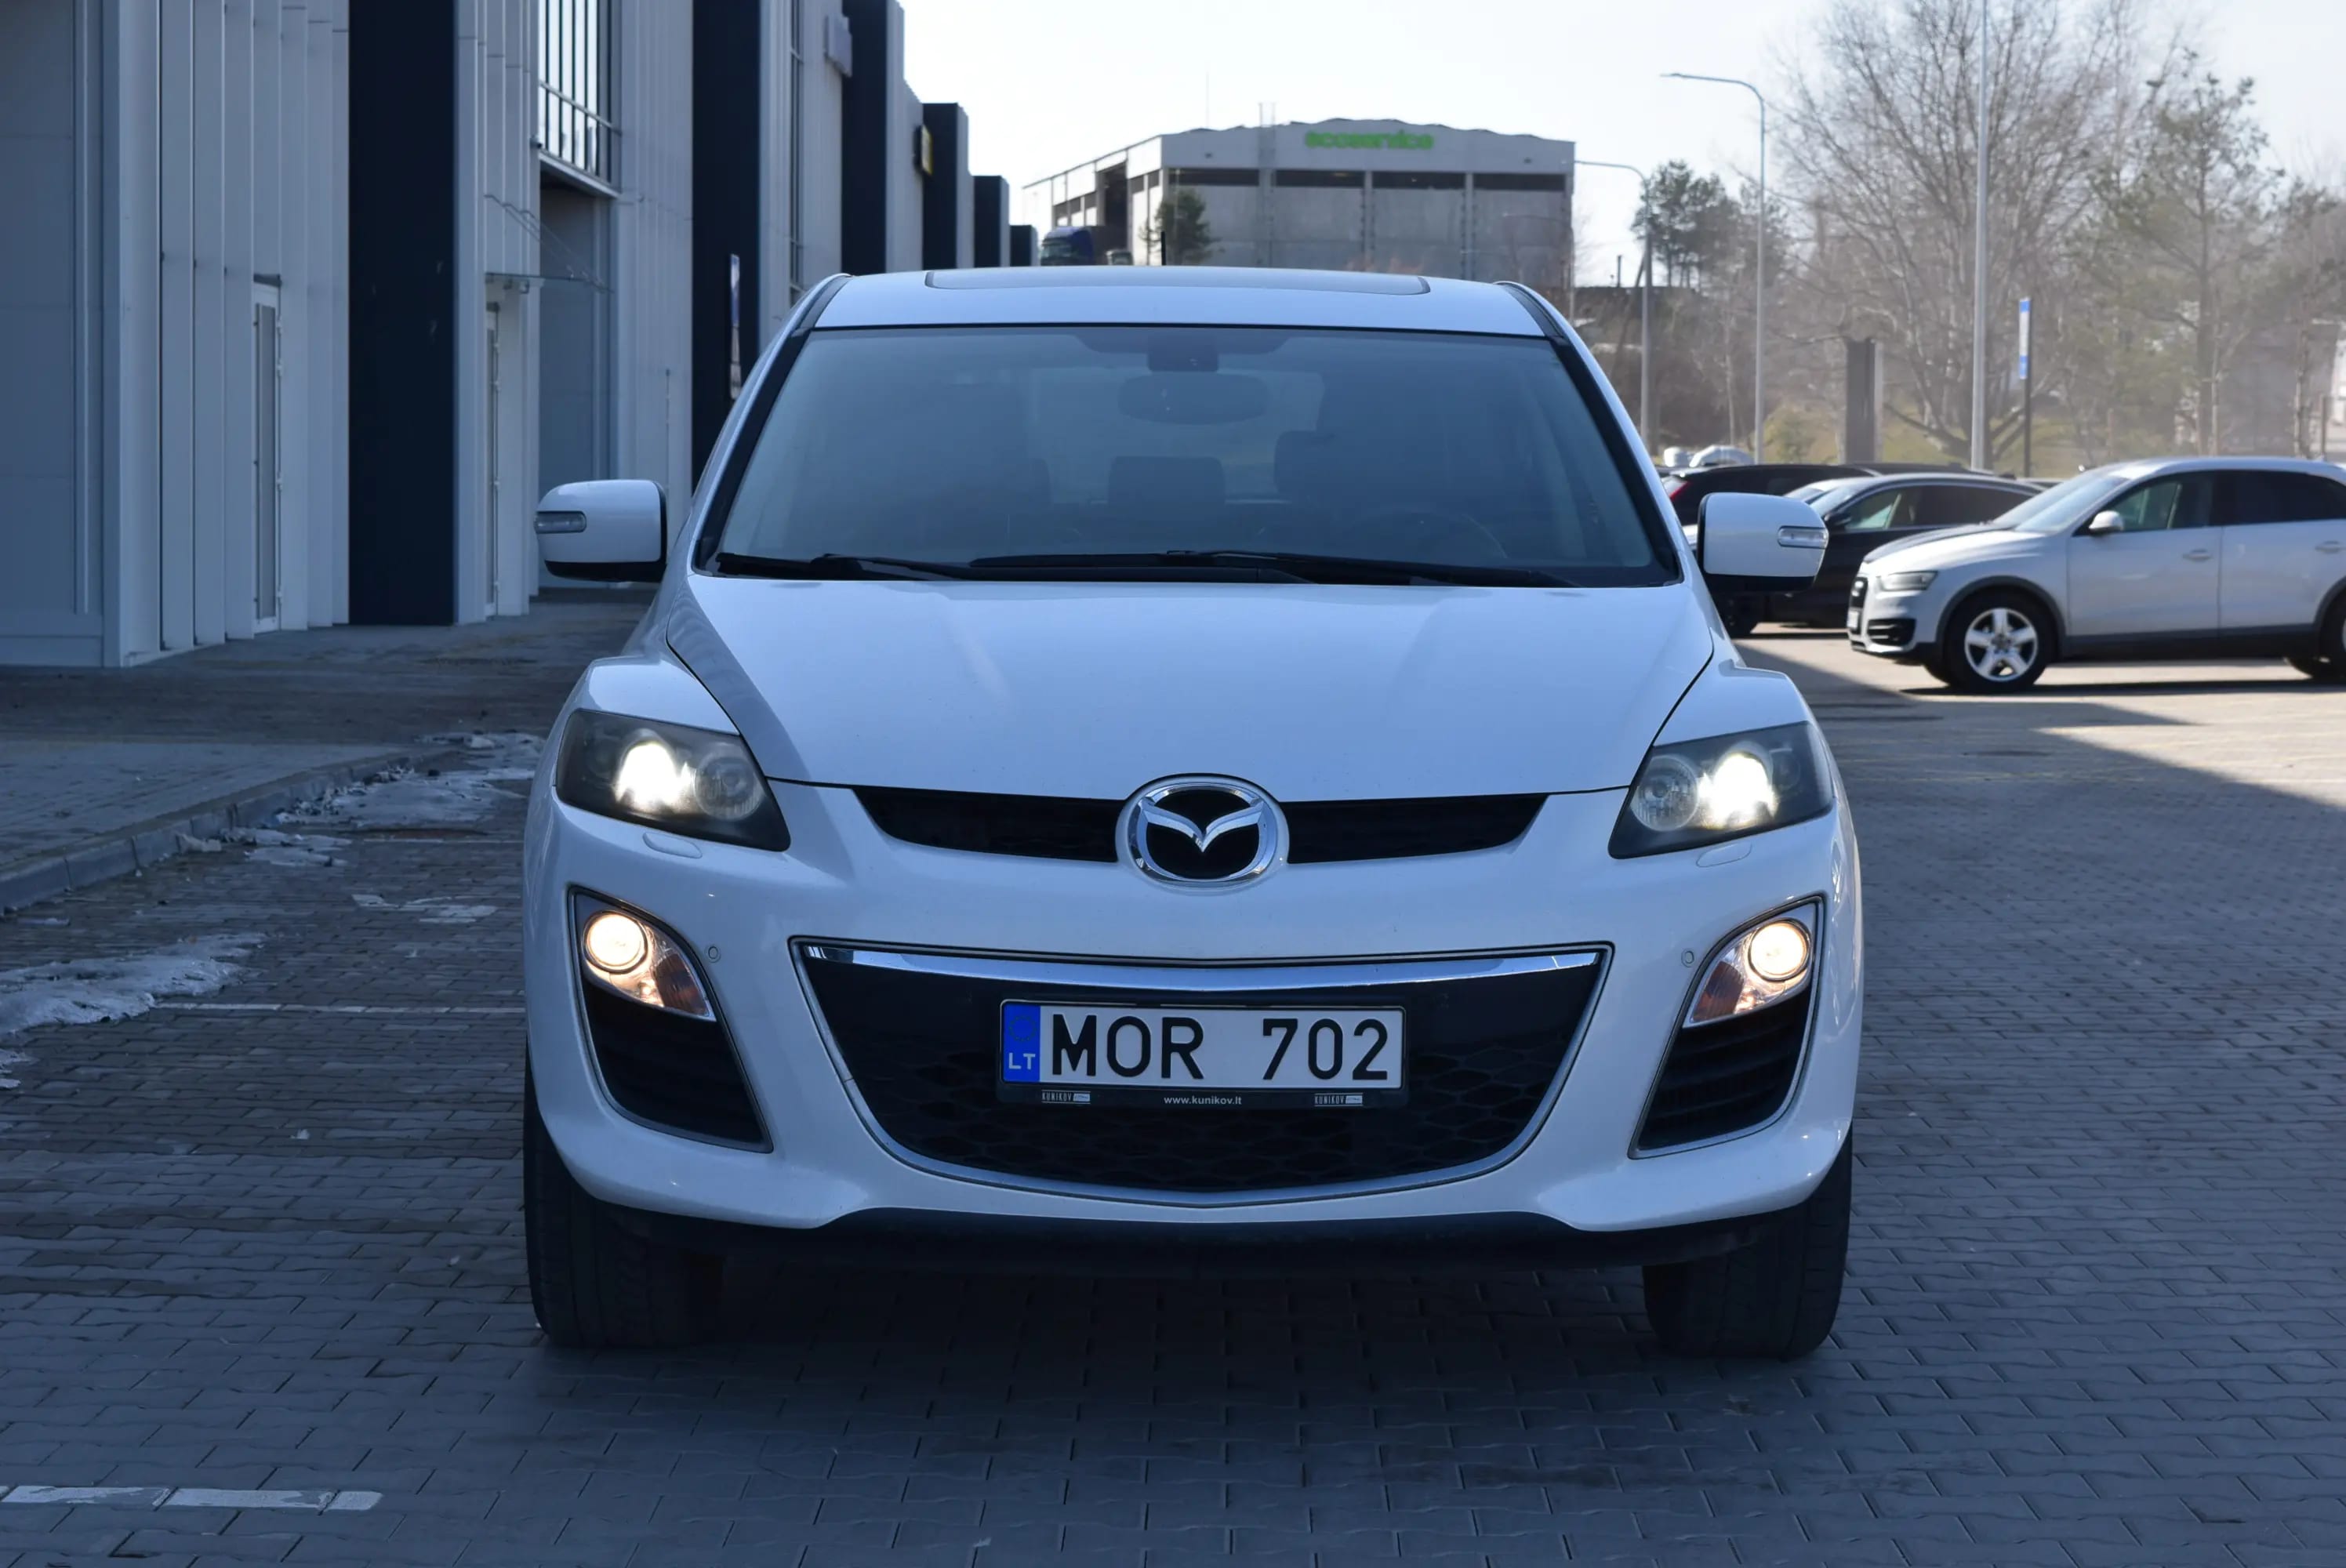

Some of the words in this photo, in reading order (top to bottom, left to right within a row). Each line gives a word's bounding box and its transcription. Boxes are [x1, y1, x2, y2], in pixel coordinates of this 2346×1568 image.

[1052, 1014, 1204, 1080] MOR
[1262, 1018, 1388, 1081] 702
[1008, 1051, 1036, 1069] LT
[1042, 1091, 1072, 1102] KUNIKOV
[1164, 1095, 1242, 1105] www.kunikov.lt
[1315, 1095, 1344, 1105] KUNIKOV
